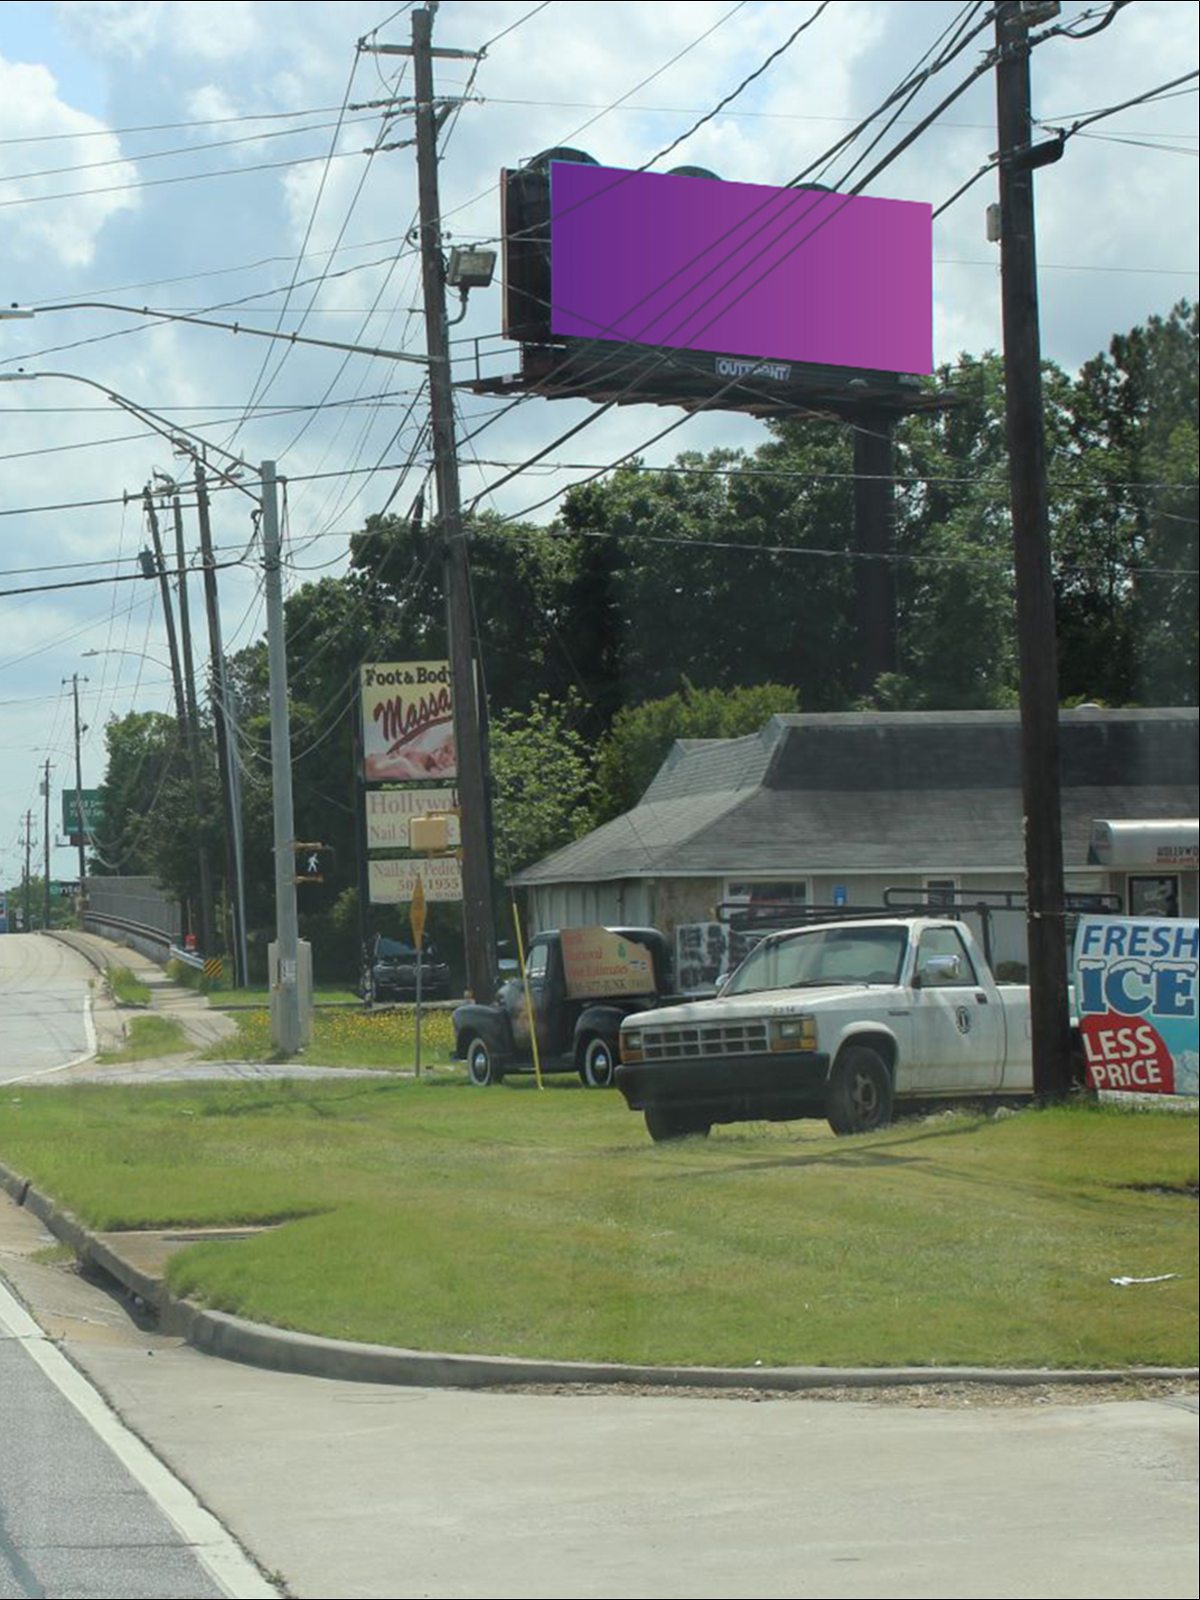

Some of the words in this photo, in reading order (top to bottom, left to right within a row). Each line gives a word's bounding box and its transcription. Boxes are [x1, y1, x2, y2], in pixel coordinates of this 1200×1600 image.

[365, 668, 402, 686] Foot
[373, 687, 452, 741] Massa
[370, 792, 457, 816] Hollywo
[370, 824, 396, 840] Nail
[373, 862, 404, 877] Nails
[399, 878, 459, 891] 50-1955
[1082, 925, 1199, 958] FRESH
[1077, 959, 1198, 1017] ICE
[1082, 1025, 1157, 1062] LESS
[1090, 1059, 1162, 1088] PRICE
